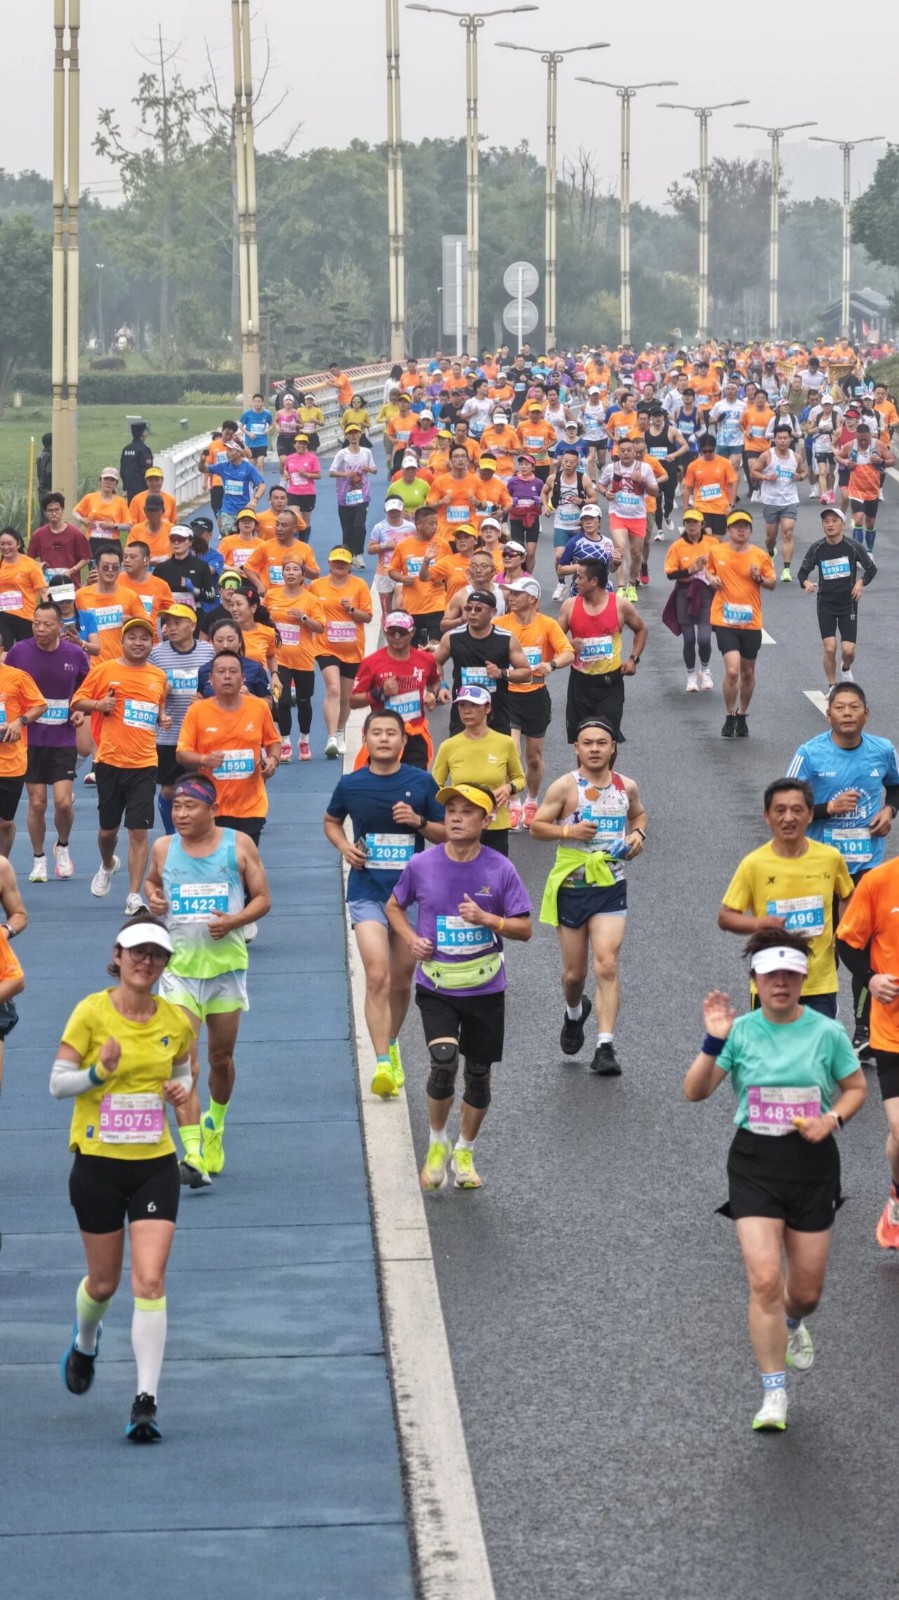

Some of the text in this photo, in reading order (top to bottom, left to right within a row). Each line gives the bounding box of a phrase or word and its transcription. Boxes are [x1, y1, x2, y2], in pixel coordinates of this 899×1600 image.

[222, 761, 246, 771] 1559
[376, 848, 406, 858] 2029
[172, 898, 216, 911] B 1422
[785, 912, 814, 928] 496
[437, 931, 482, 942] B 1966
[749, 1106, 805, 1120] B 4833
[100, 1113, 152, 1128] B 5075
